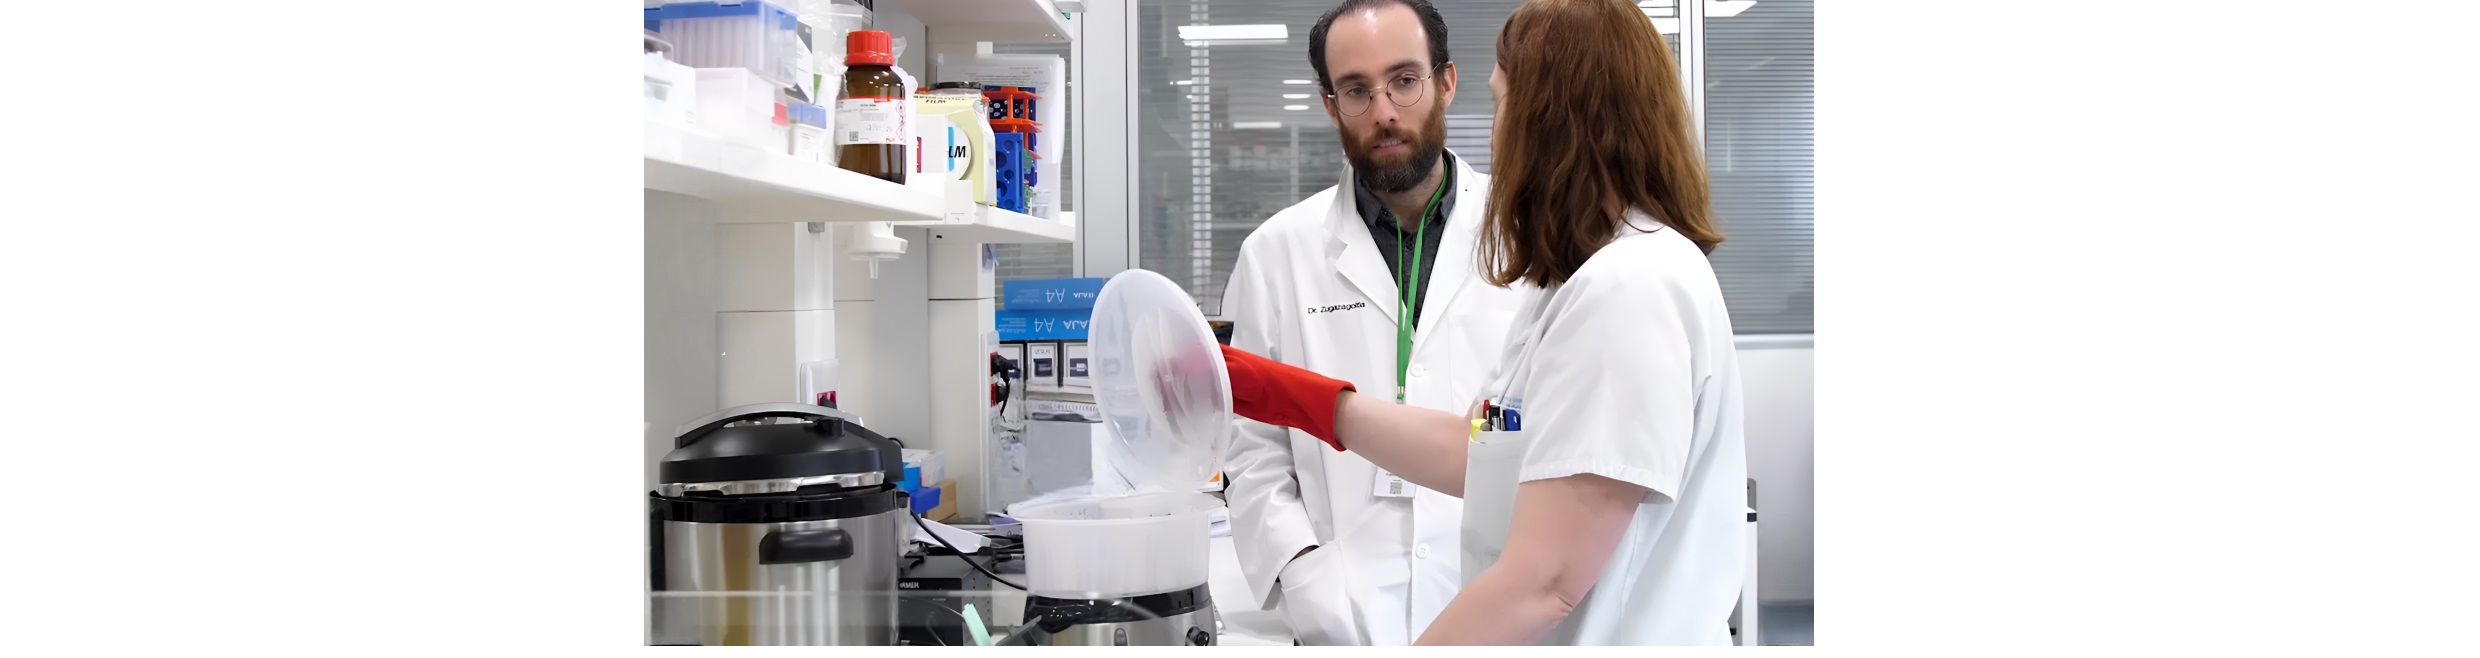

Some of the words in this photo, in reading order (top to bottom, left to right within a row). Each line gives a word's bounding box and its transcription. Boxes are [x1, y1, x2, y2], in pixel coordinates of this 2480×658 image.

[948, 145, 967, 158] LM
[1046, 288, 1065, 303] A4
[1034, 318, 1054, 332] A4
[1063, 320, 1088, 330] AJA
